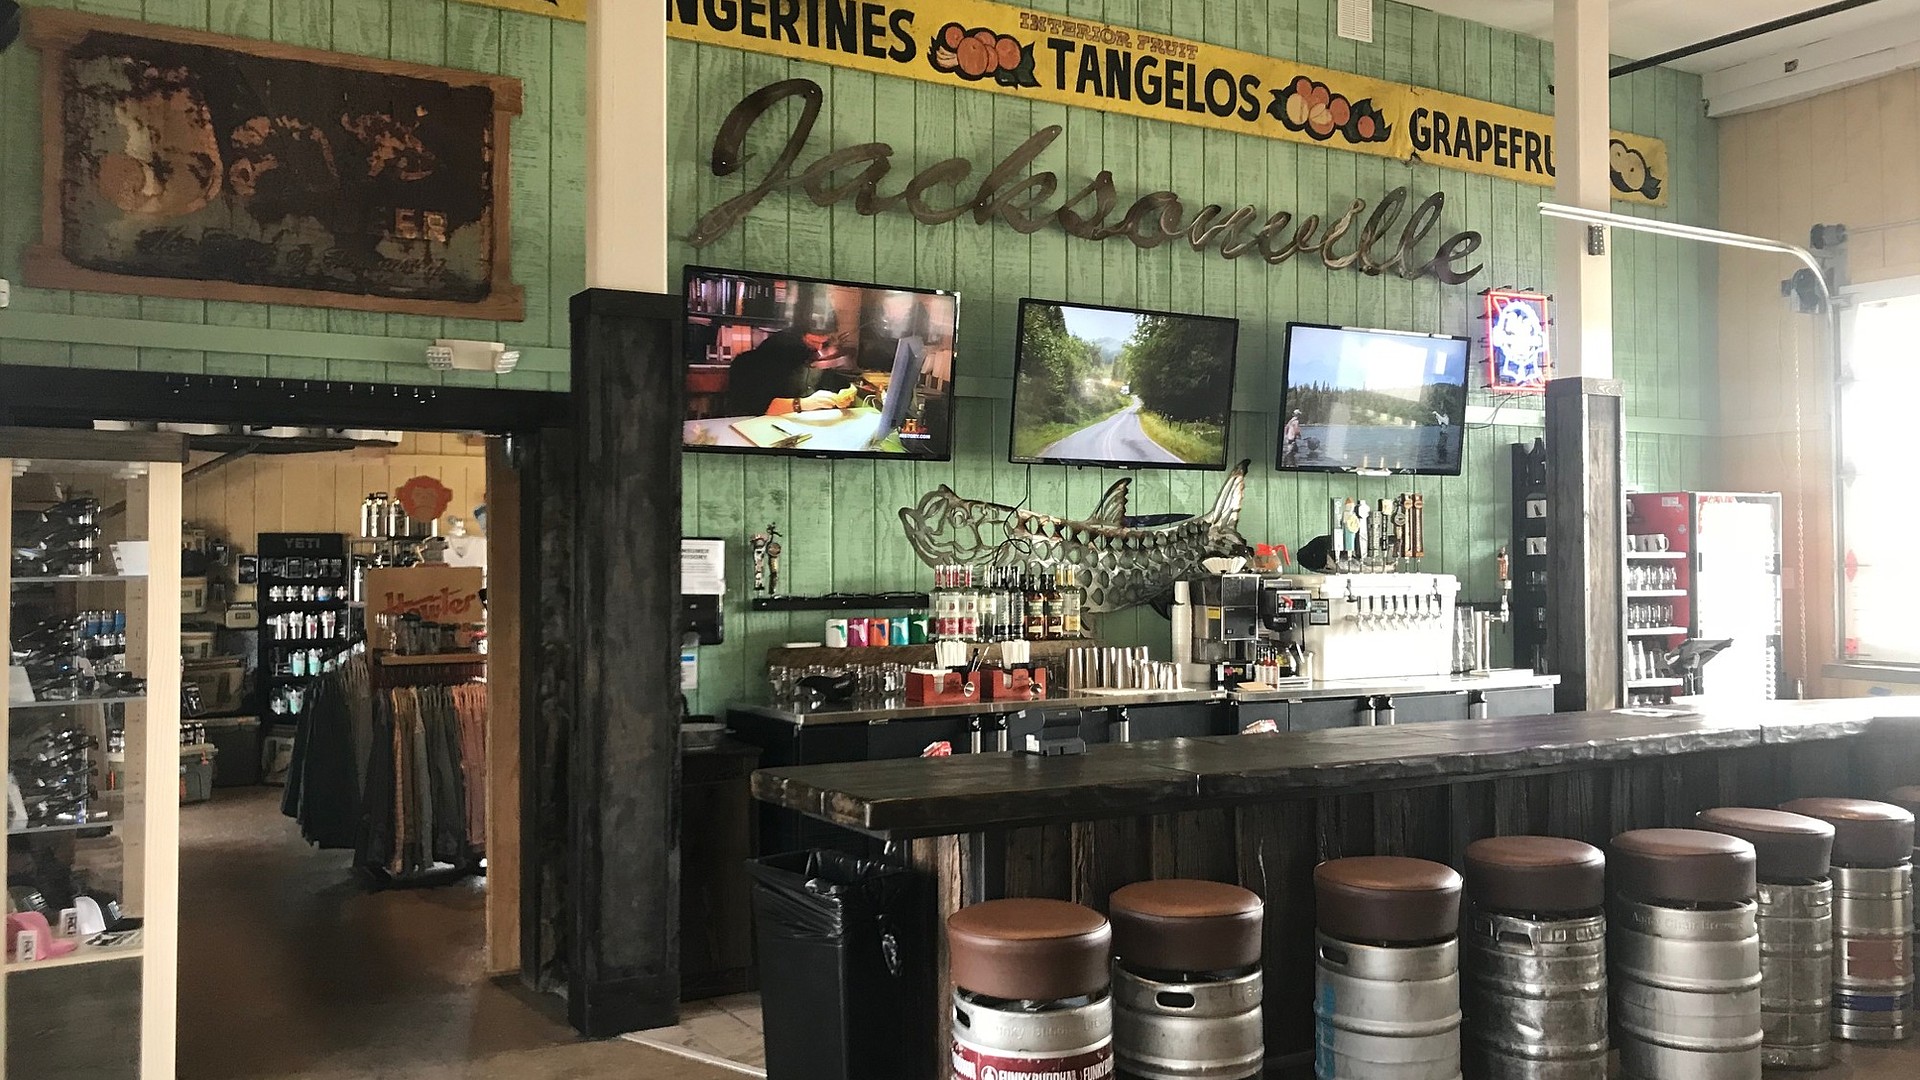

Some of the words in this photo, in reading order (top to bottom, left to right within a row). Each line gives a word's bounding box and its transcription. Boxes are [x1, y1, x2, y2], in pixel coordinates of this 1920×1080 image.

[1019, 12, 1133, 51] INTERIOR
[1136, 33, 1199, 60] FRUIT
[1046, 37, 1263, 122] TANGELOS
[687, 77, 1485, 286] Jacksonville
[285, 537, 321, 549] YETI
